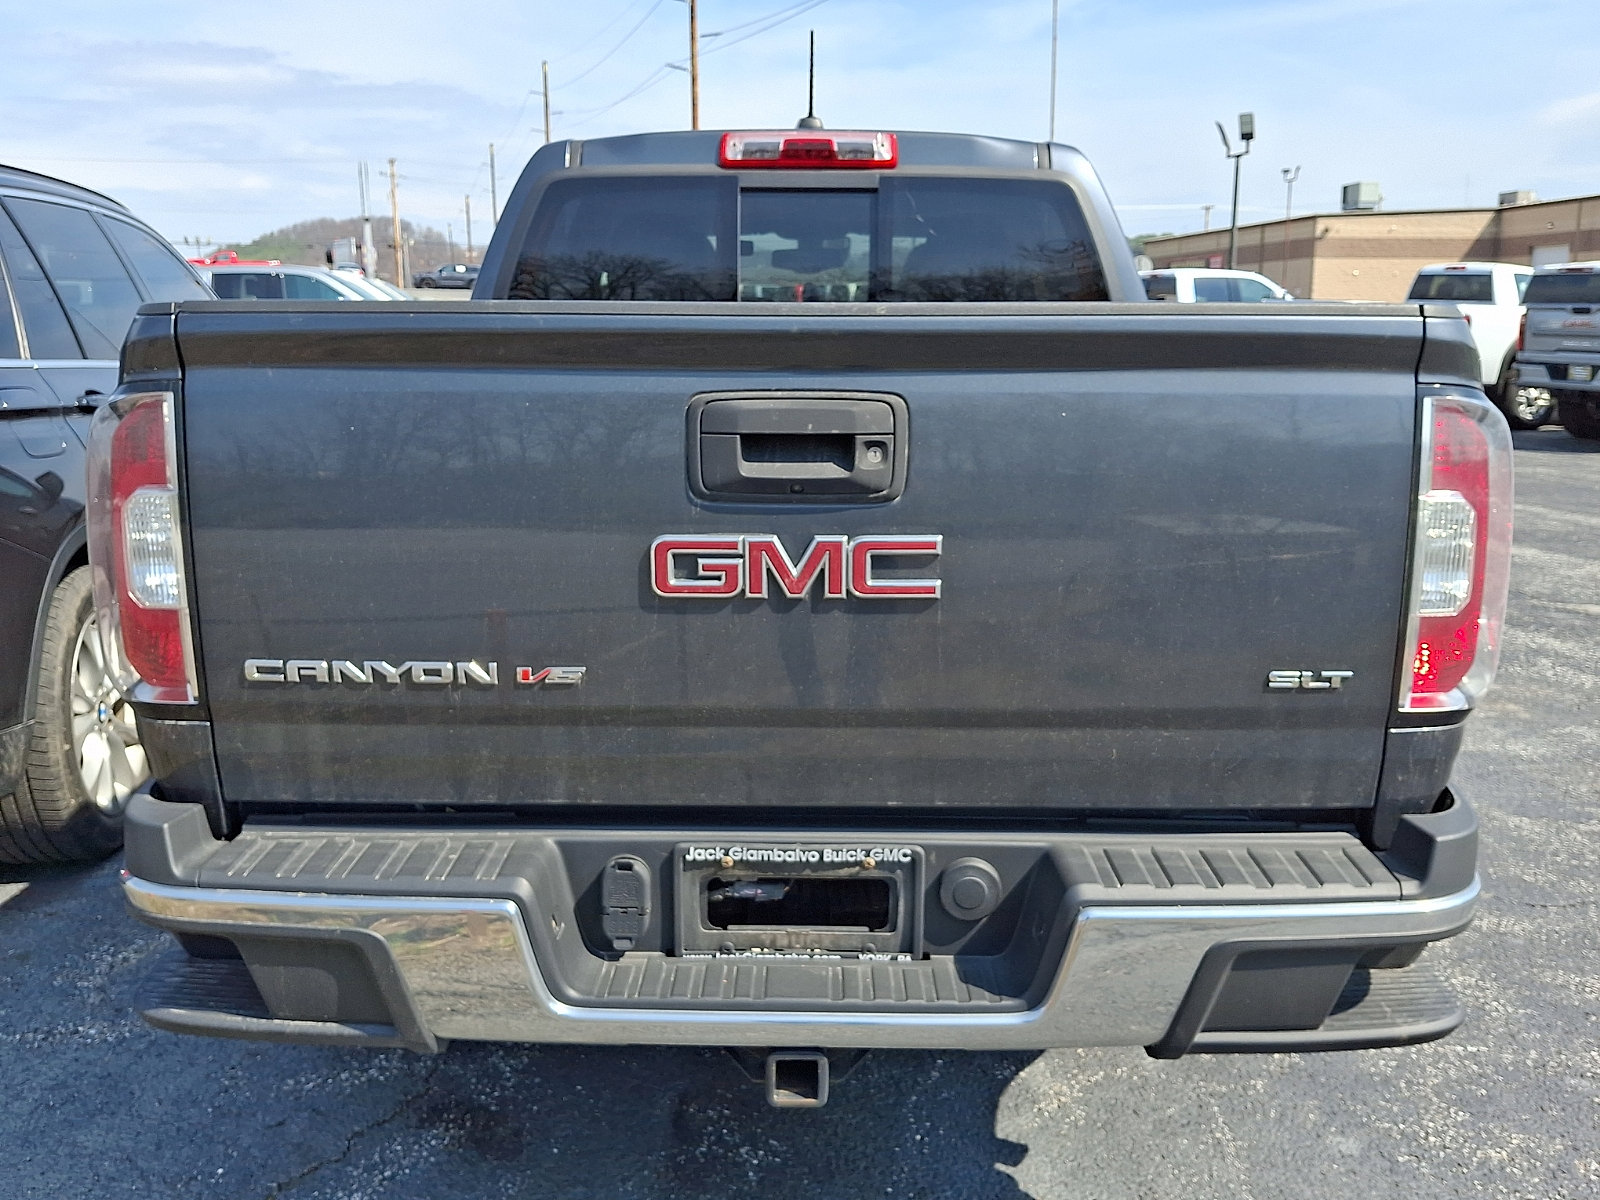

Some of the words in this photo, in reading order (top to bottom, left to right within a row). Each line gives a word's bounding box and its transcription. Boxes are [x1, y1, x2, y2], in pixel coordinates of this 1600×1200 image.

[650, 534, 943, 599] GMC
[244, 658, 498, 685] CANYON
[1268, 670, 1354, 689] SLT
[685, 846, 725, 862] Jack
[729, 847, 820, 863] Giambalvo
[823, 848, 867, 863] Buick
[869, 848, 912, 863] GMC
